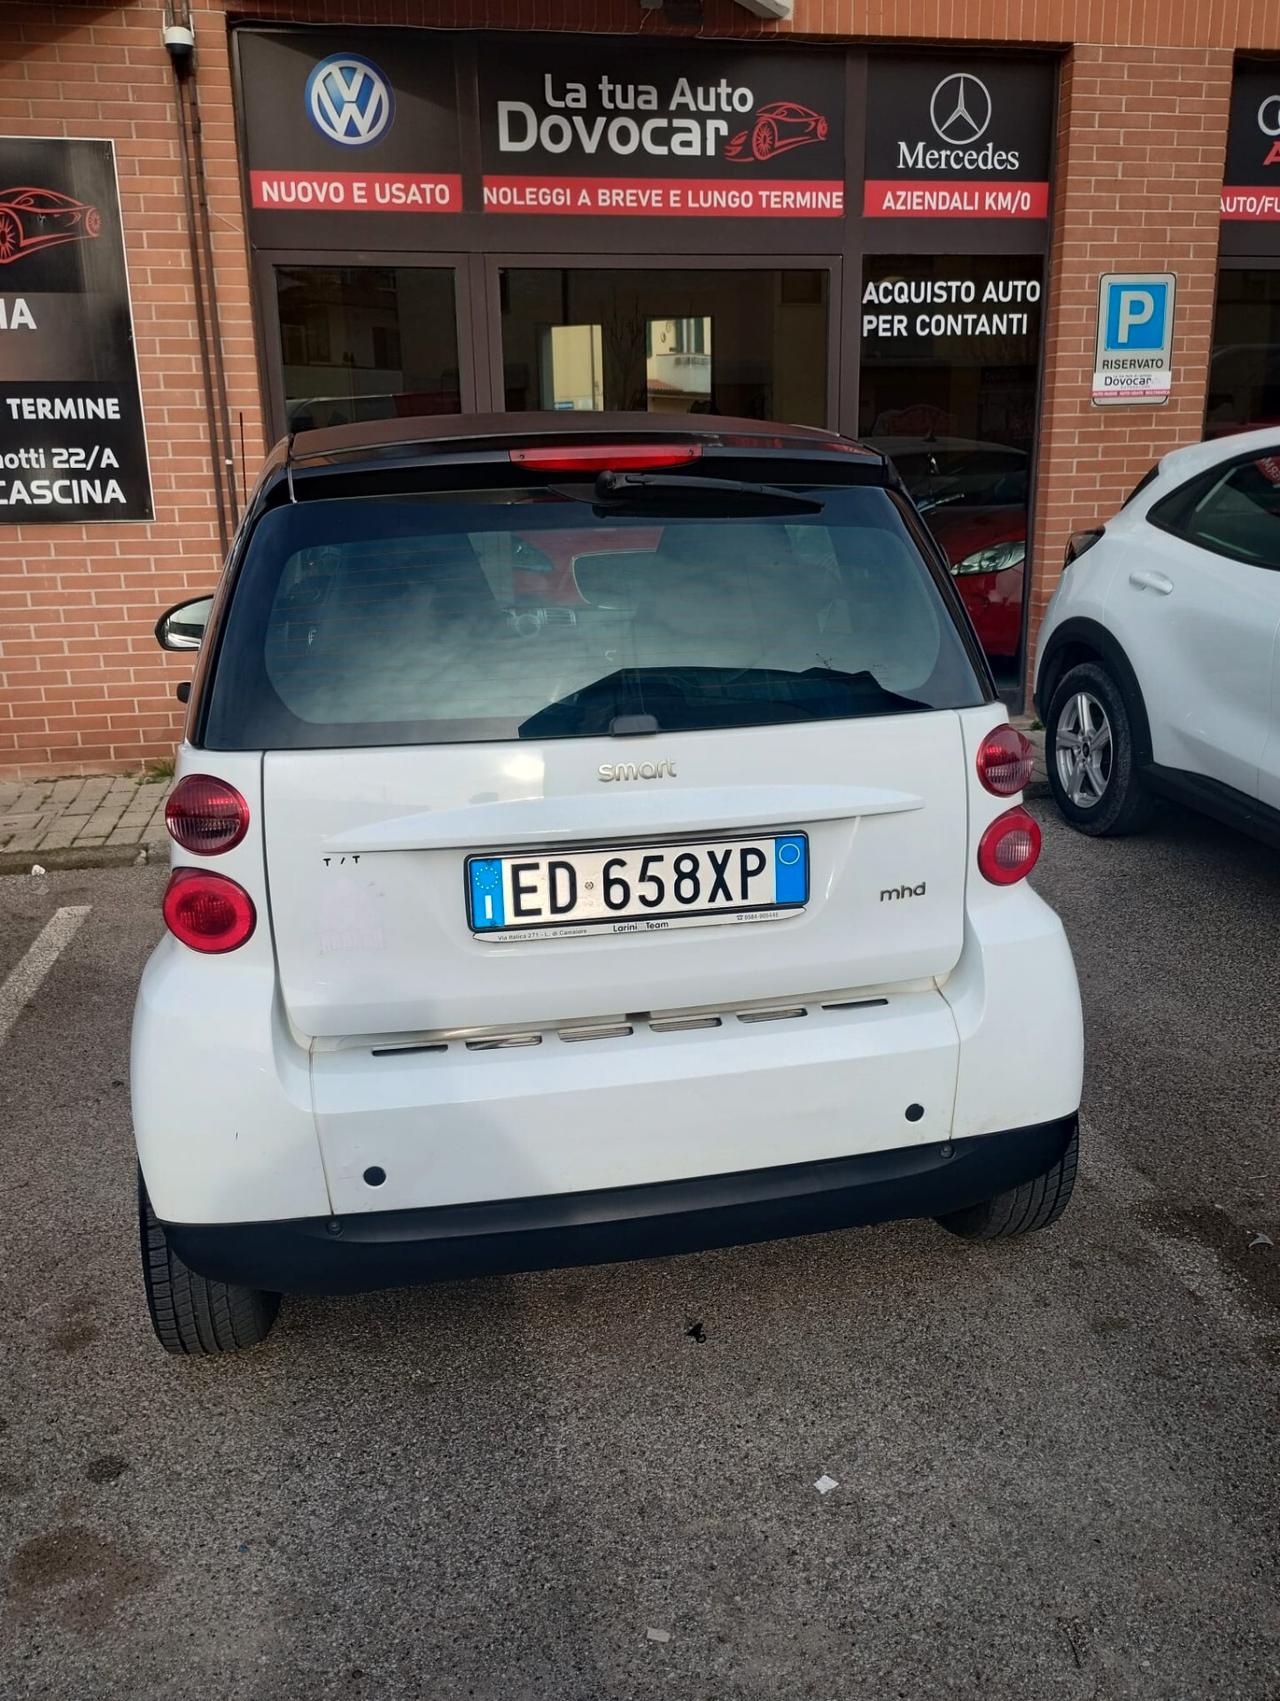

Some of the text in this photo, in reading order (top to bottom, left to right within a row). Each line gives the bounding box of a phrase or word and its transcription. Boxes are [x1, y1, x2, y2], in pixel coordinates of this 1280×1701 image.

[544, 73, 754, 113] La tua Auto
[497, 100, 728, 157] Dovocar
[897, 141, 1020, 171] Mercedes
[261, 181, 450, 206] NUOVO E USATO
[483, 187, 844, 210] NOLEGGI A BREVE E LUNGO TERMINE
[882, 191, 979, 211] AZIENDALI
[862, 280, 1041, 305] ACQUISTO AUTO
[0, 298, 38, 330] A
[863, 313, 1028, 338] PER CONTANTI
[1117, 291, 1154, 342] P
[1102, 358, 1164, 370] RISERVATO
[1104, 375, 1152, 386] Dovocar
[6, 398, 121, 420] TERMINE
[51, 445, 120, 471] 22/A
[598, 757, 677, 782] smart
[511, 861, 578, 918] ED
[602, 847, 767, 911] 658XP
[880, 881, 926, 902] mhd
[613, 920, 670, 933] Larini Team
